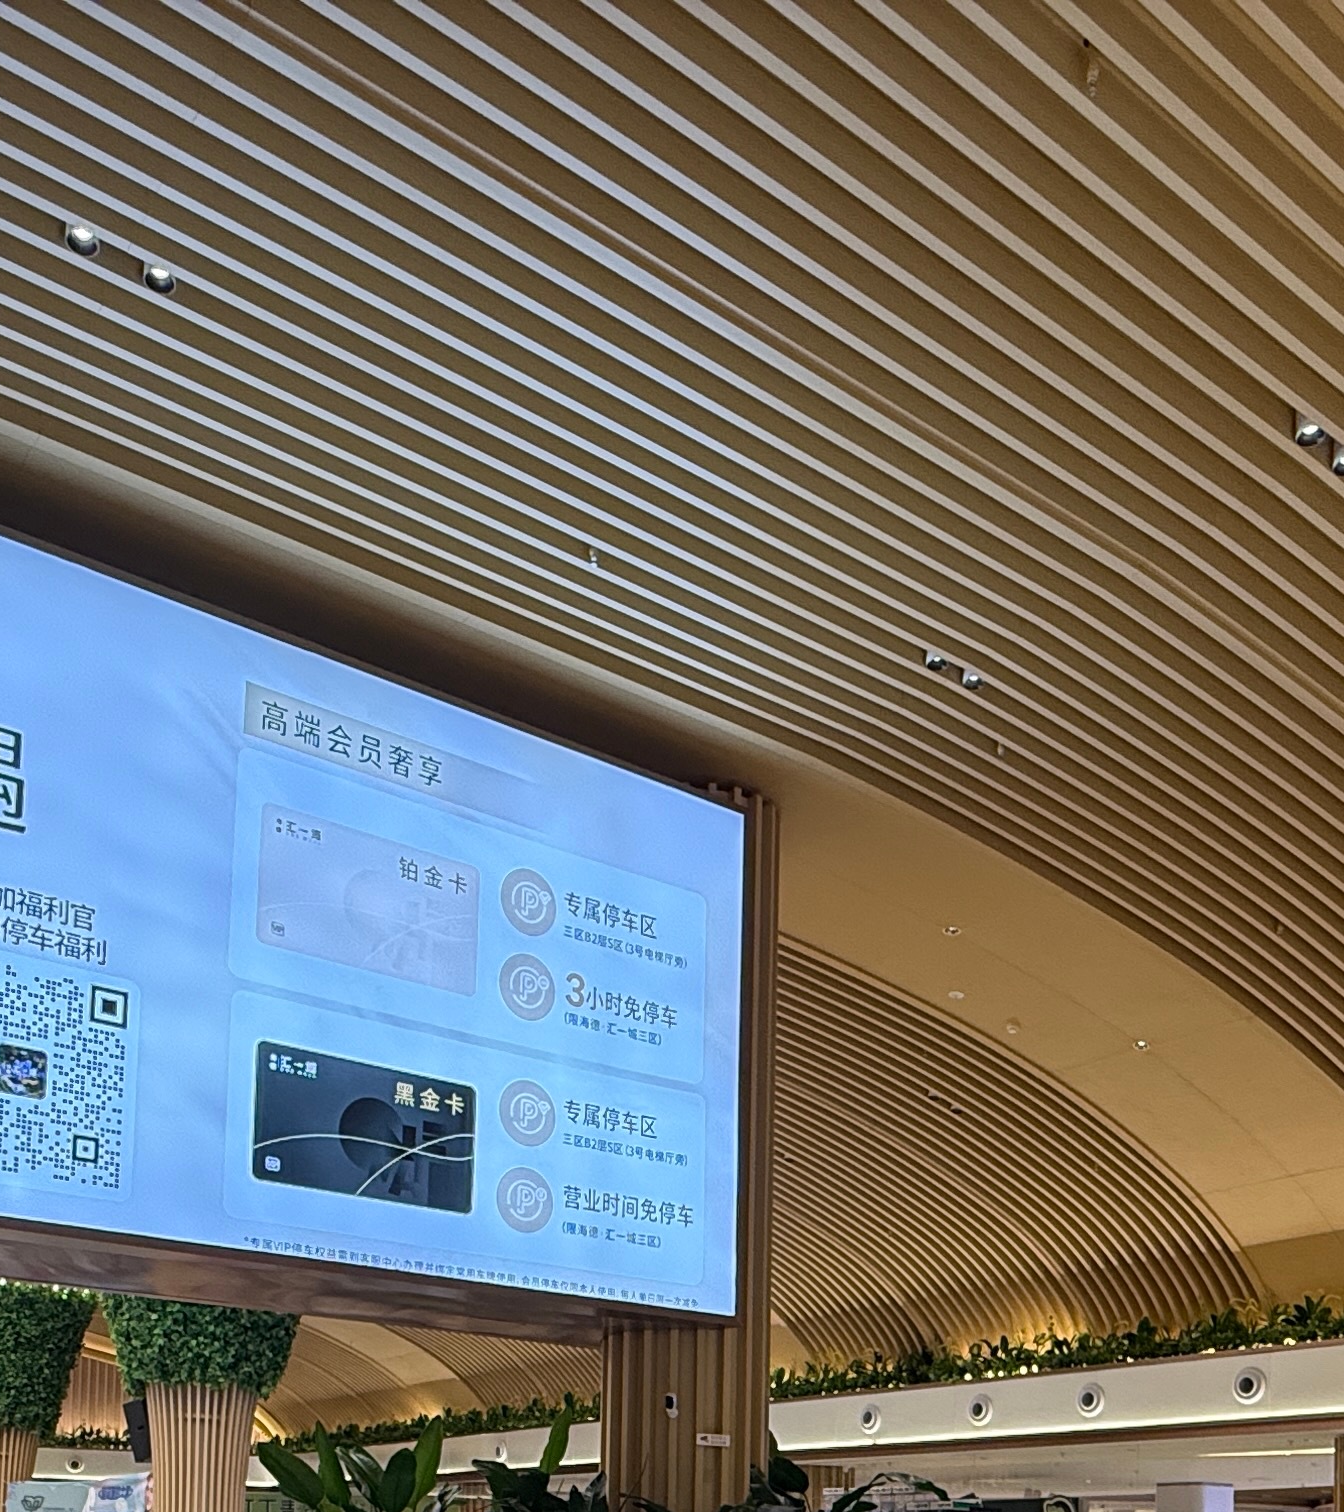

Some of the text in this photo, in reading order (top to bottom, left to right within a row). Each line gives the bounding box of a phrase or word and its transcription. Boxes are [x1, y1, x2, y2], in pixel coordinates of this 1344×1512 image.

[260, 698, 444, 787] 高端会员奢享
[398, 856, 468, 895] 铂金卡
[563, 891, 658, 940] 专属停车区
[564, 972, 678, 1030] 3小时免停车
[393, 1081, 466, 1117] 黑金卡
[563, 1099, 658, 1139] 专属停车区
[563, 1184, 694, 1228] 营业时间免停车
